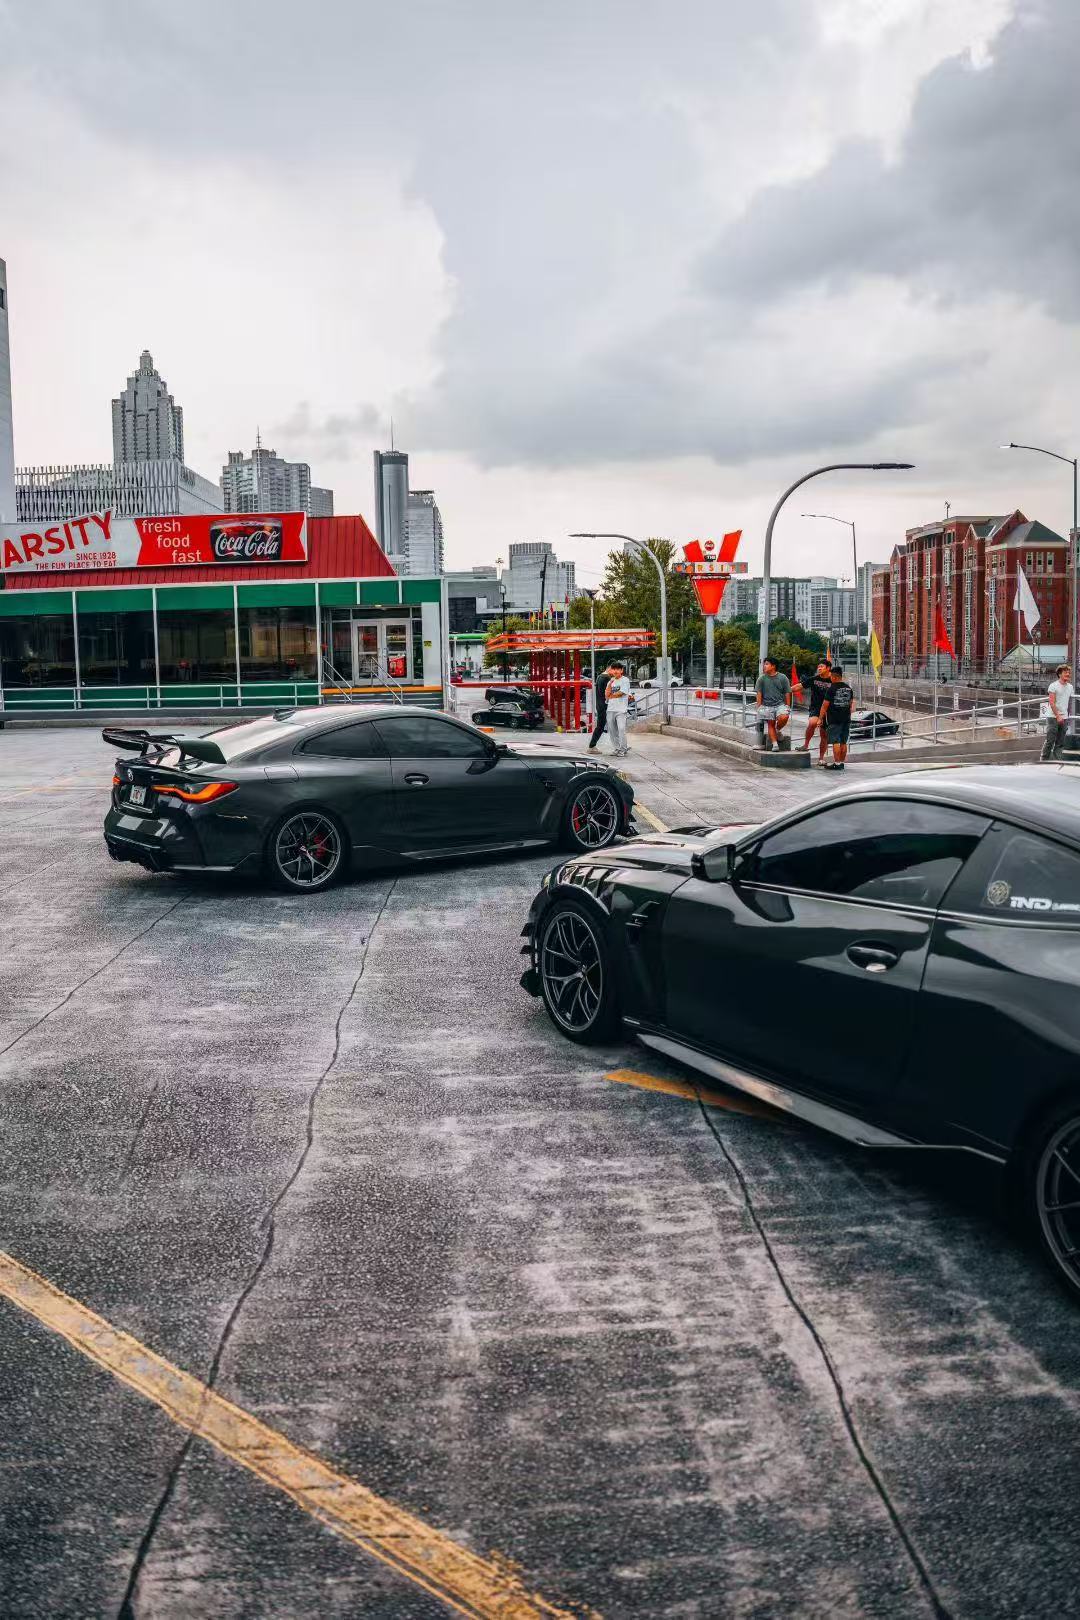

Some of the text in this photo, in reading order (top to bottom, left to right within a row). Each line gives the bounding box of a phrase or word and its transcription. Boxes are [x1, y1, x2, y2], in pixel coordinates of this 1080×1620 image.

[141, 519, 181, 534] fresh
[0, 511, 111, 568] ARSITY
[157, 533, 190, 548] food
[215, 530, 280, 557] Coca-Cola
[76, 551, 117, 560] SINCE 1928
[172, 549, 202, 563] fast
[51, 562, 66, 570] FUN
[69, 561, 90, 569] PLACE
